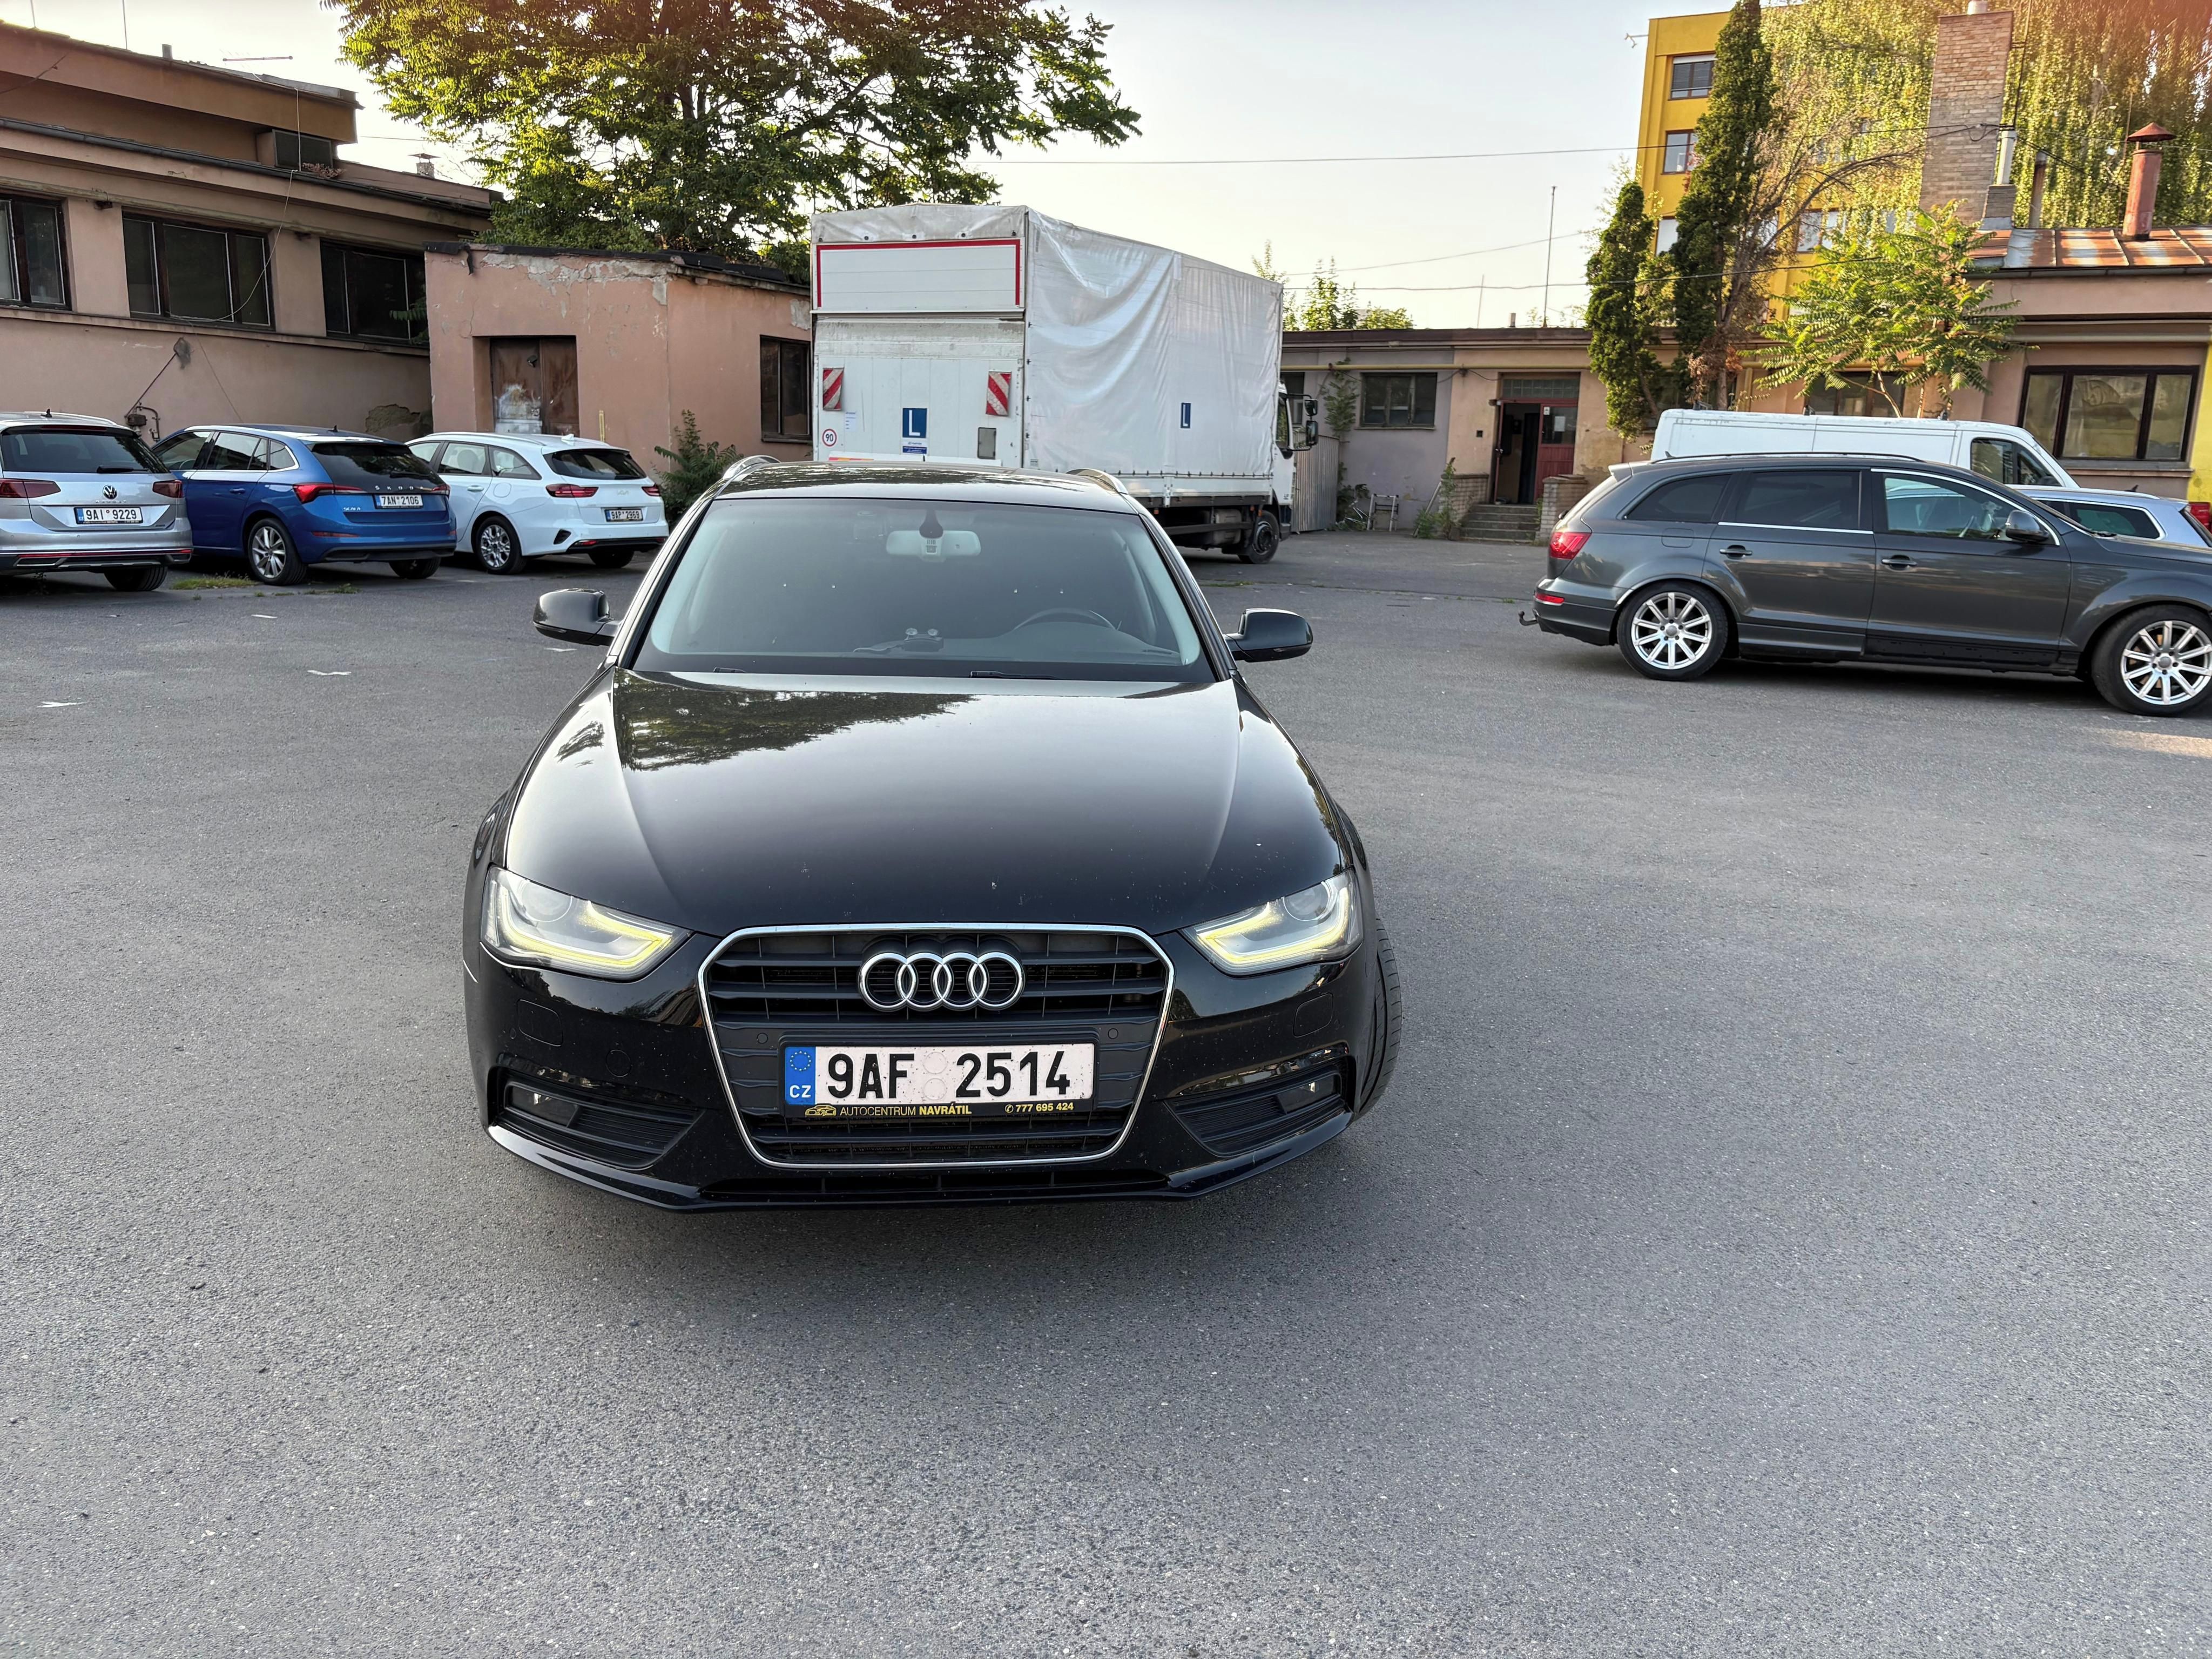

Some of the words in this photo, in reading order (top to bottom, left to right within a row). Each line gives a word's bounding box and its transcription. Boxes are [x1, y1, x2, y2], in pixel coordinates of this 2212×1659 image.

[909, 410, 921, 436] L
[825, 434, 833, 442] 90
[381, 496, 396, 505] 7AN
[401, 496, 419, 505] 2106
[86, 509, 104, 520] 9AI
[112, 509, 137, 520] 9229
[827, 1053, 915, 1098] 9AF
[956, 1050, 1070, 1098] 2514
[790, 1084, 811, 1098] CZ
[840, 1107, 916, 1116] AUTOCENTRUM
[919, 1103, 972, 1115] NAVRÁTIL
[1016, 1104, 1034, 1112] 777
[1036, 1103, 1054, 1112] 695
[1056, 1102, 1074, 1111] 424
